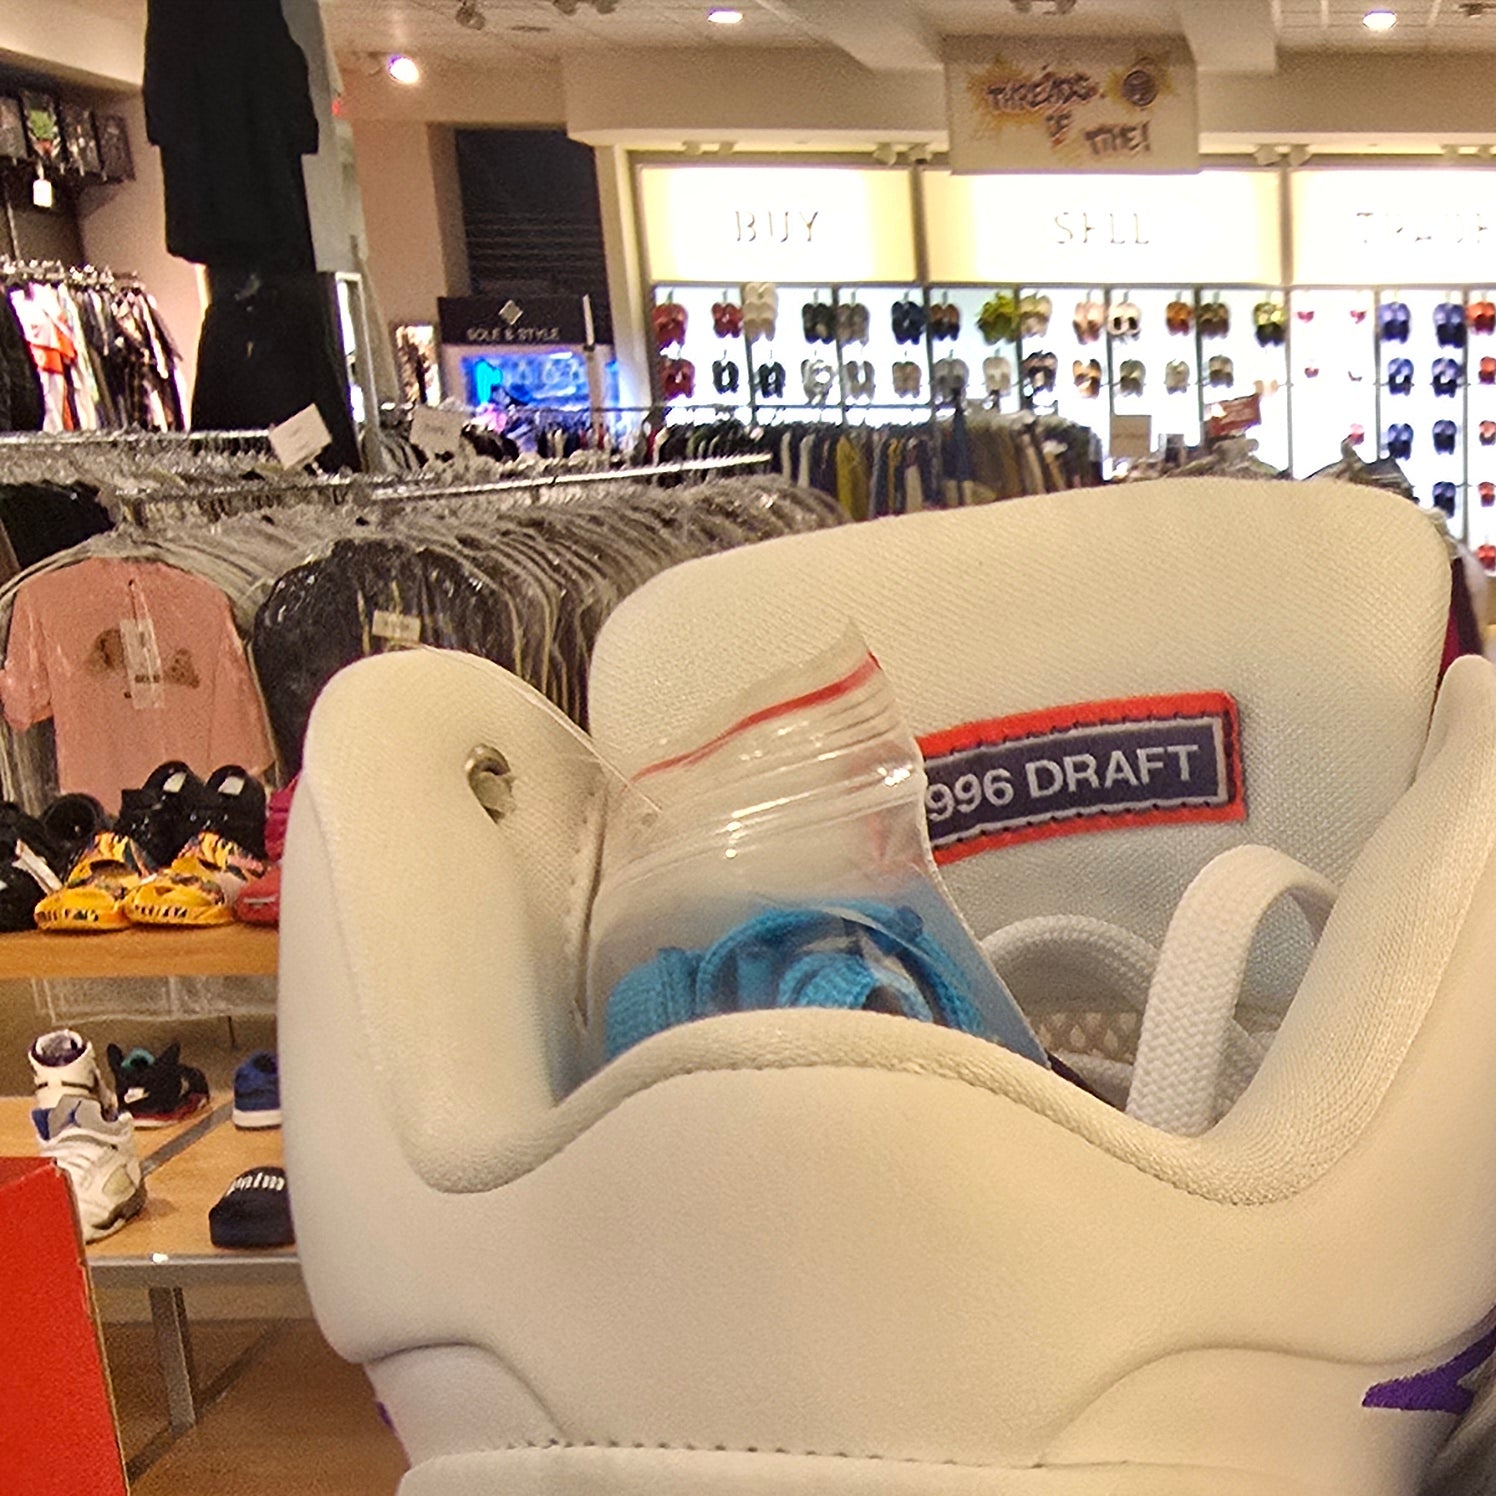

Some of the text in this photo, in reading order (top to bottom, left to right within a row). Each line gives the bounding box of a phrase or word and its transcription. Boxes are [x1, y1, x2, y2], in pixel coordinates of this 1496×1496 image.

[735, 210, 819, 243] BUY
[925, 744, 1199, 821] 996 DRAFT
